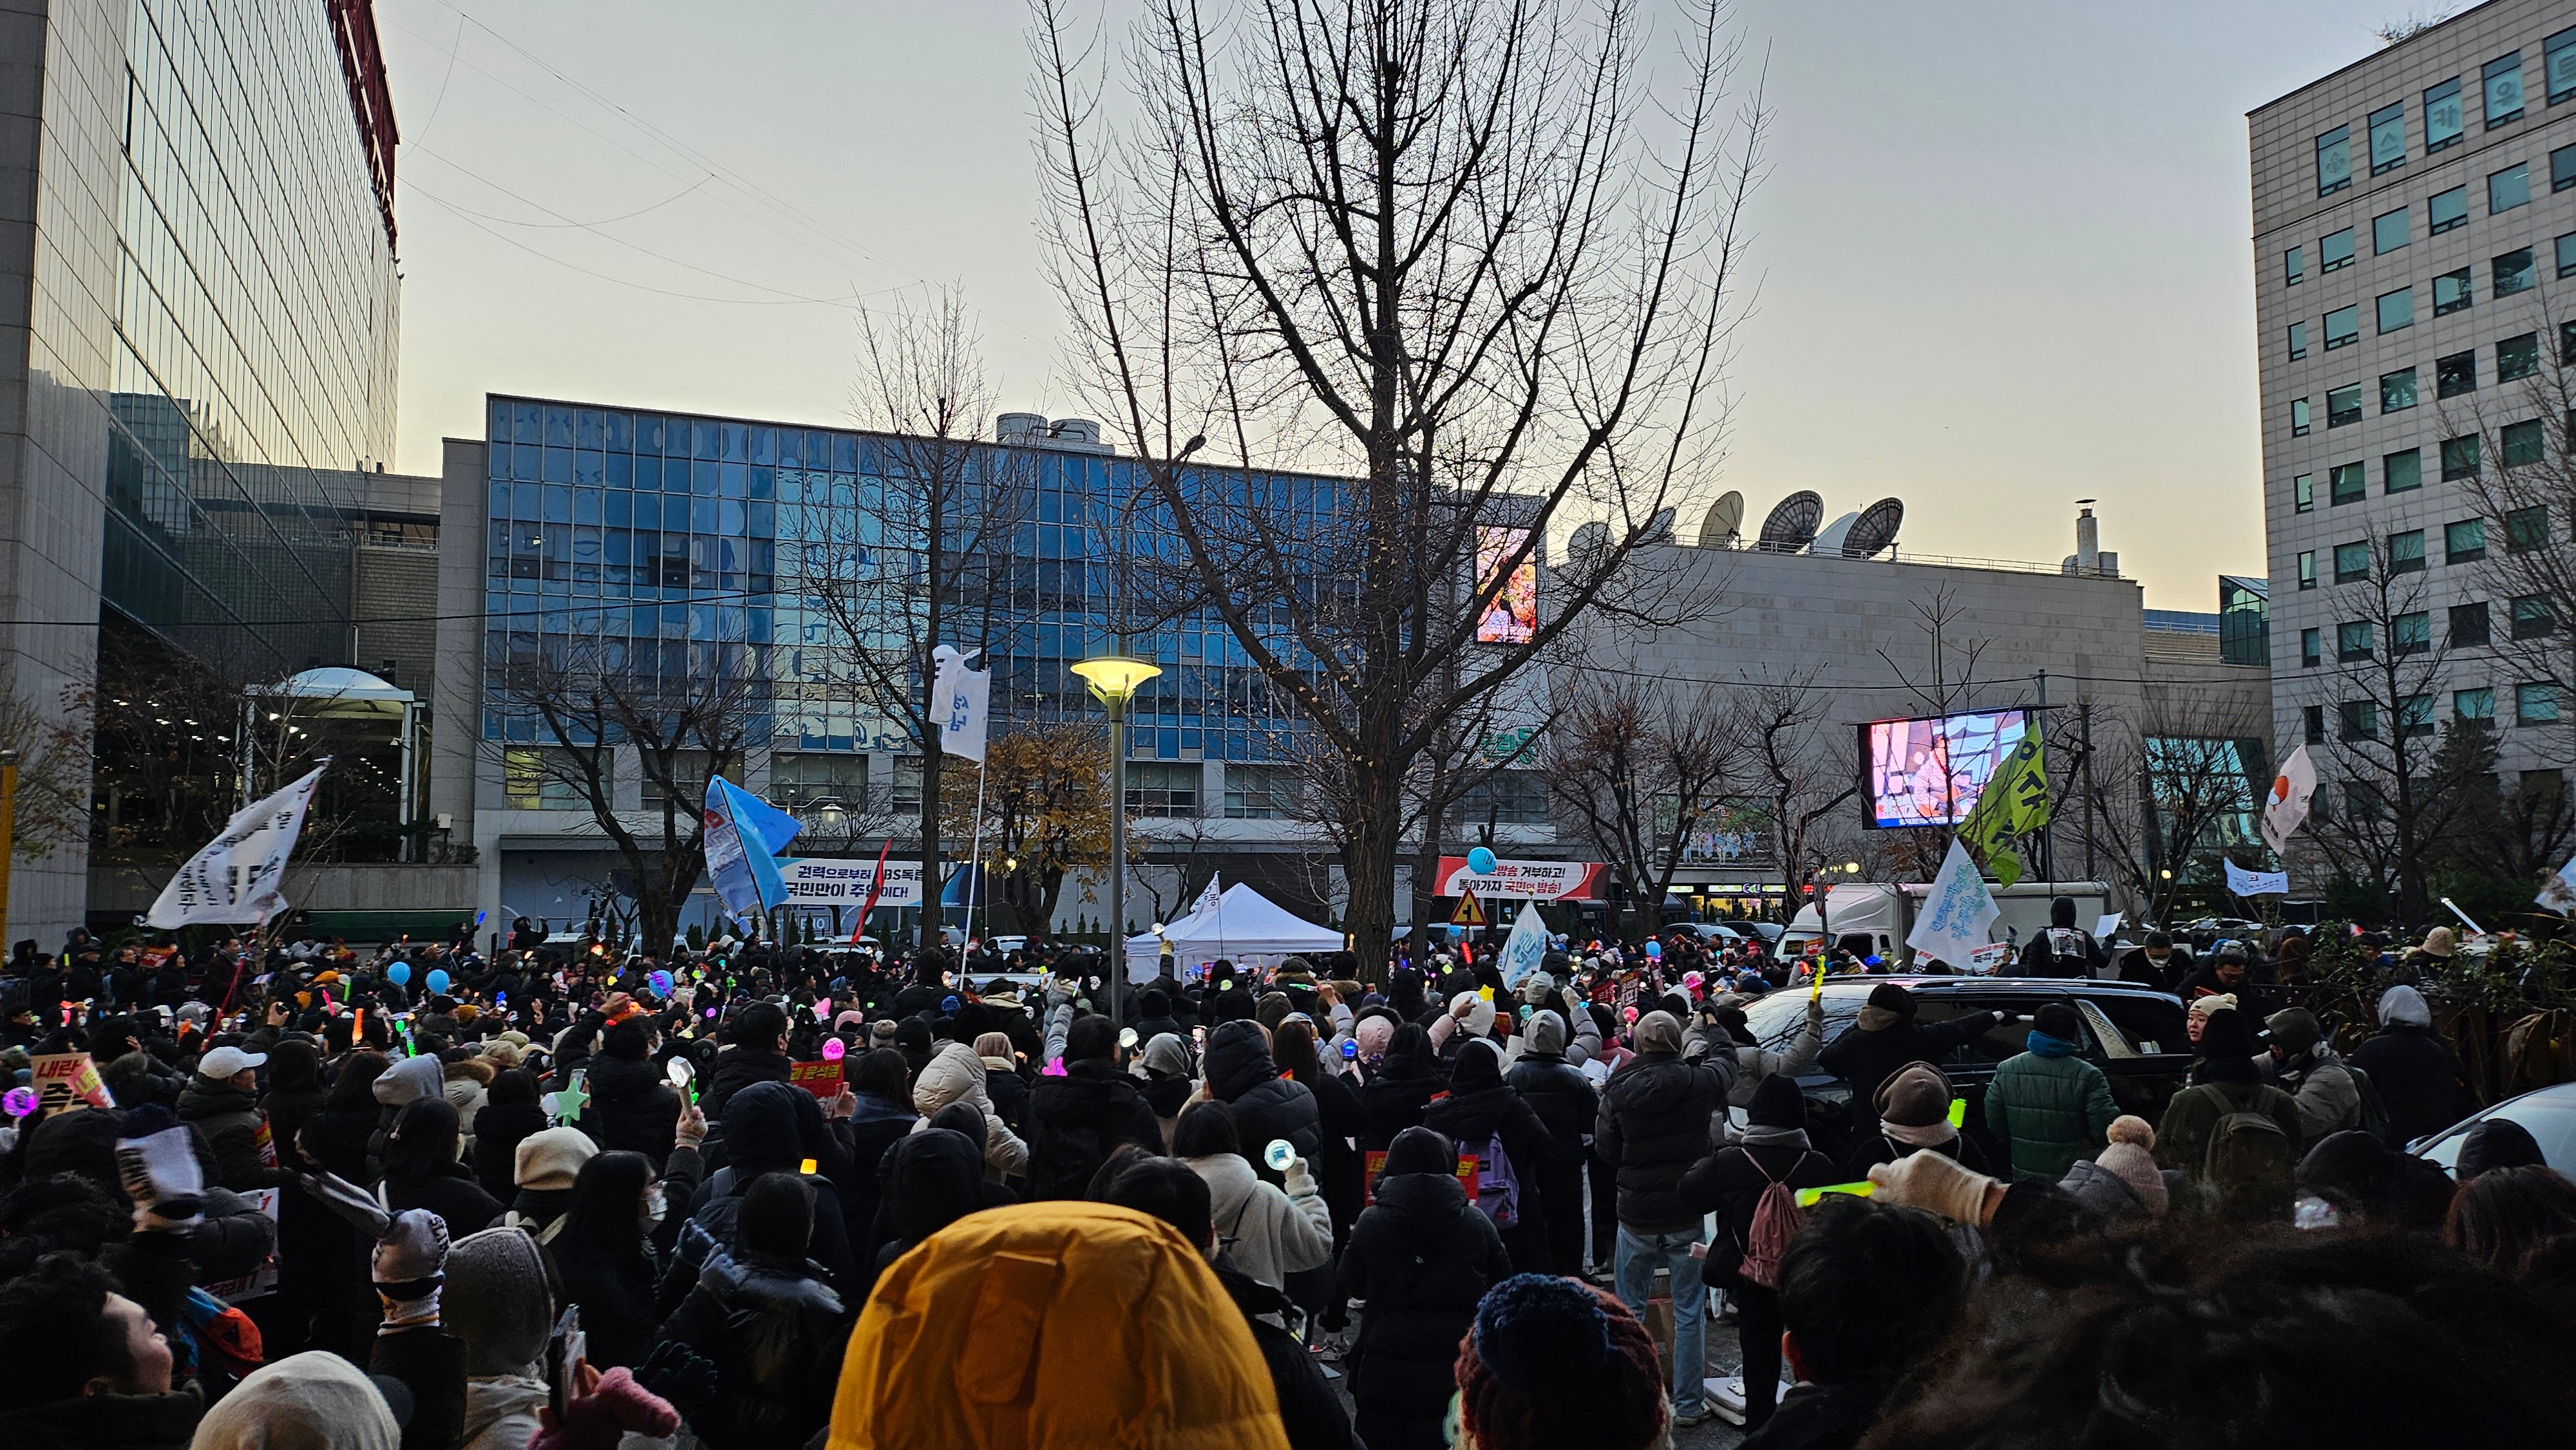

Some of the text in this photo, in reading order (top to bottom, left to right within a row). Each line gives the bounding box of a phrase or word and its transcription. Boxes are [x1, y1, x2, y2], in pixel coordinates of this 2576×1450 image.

[797, 865, 923, 881] 권력으로부터 BS독립
[1520, 866, 1566, 878] 거부하고!
[785, 881, 846, 898] 국민만이
[1458, 879, 1502, 892] 돌아가자
[1537, 882, 1562, 894] 방송!
